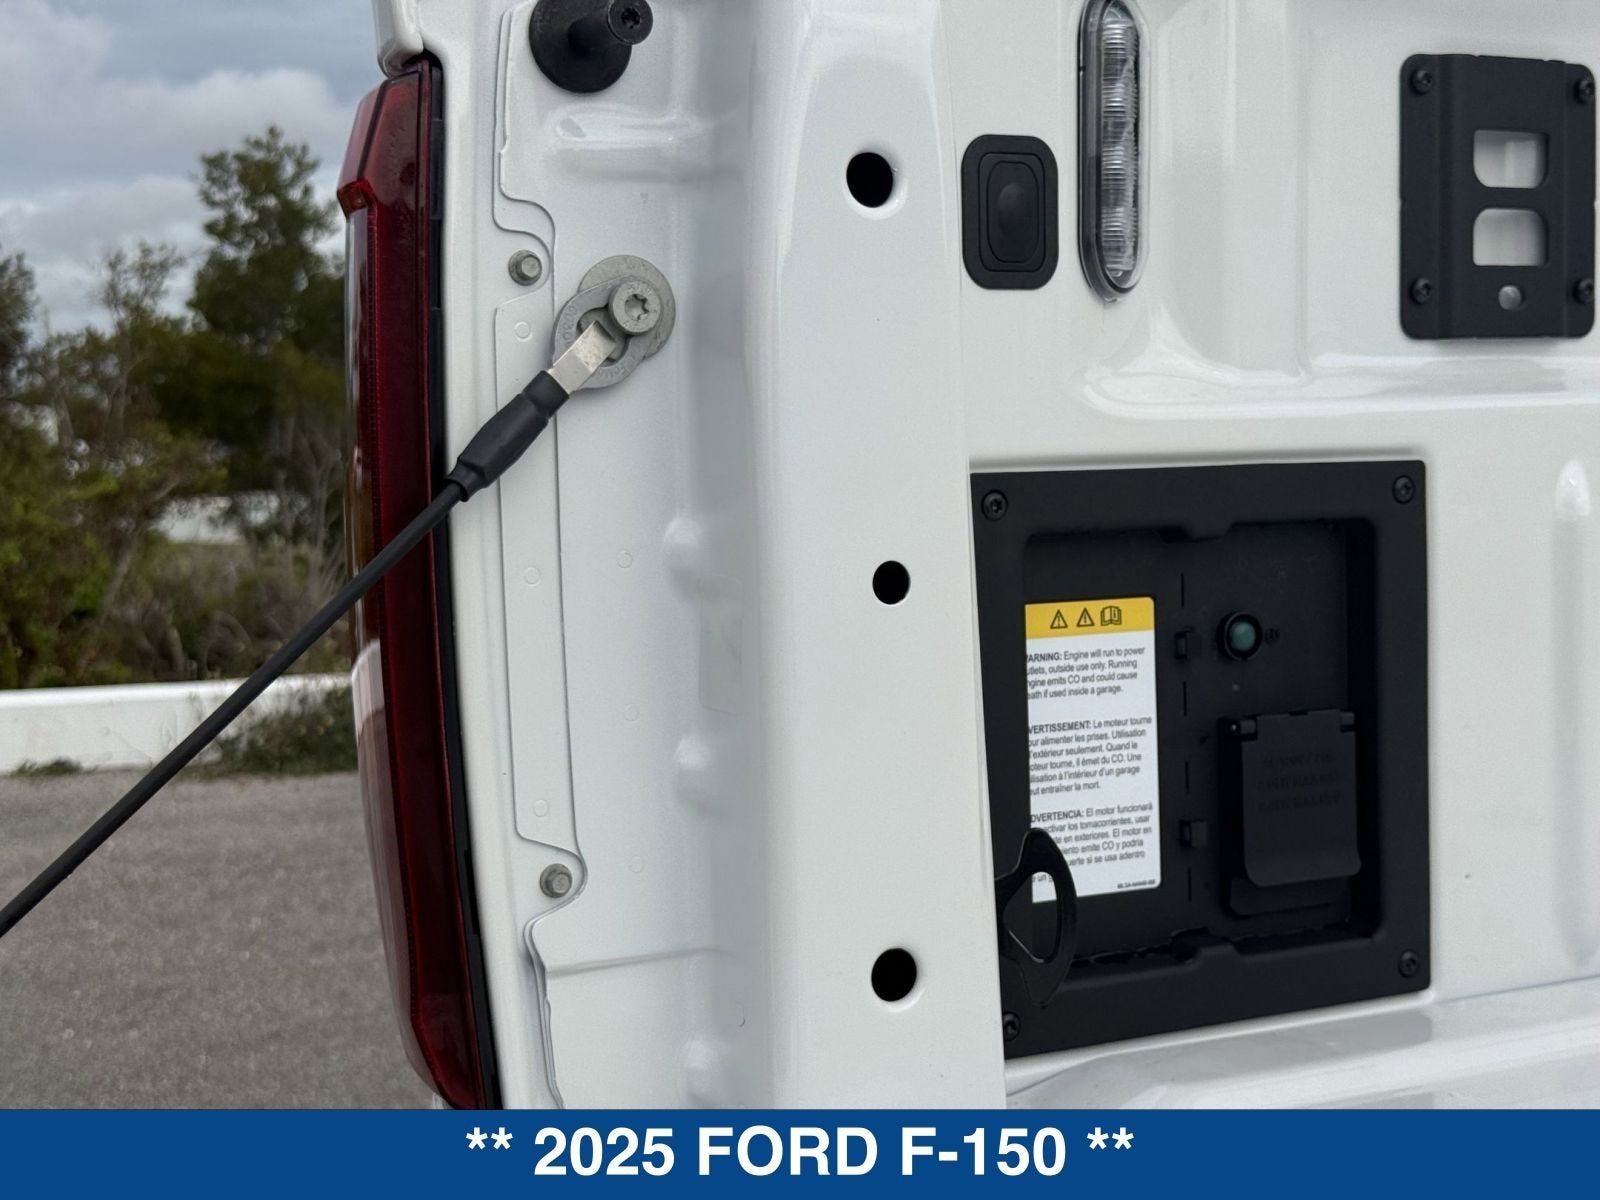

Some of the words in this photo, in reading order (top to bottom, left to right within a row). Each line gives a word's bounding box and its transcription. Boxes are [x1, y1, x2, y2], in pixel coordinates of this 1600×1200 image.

[1064, 649, 1089, 662] Engine
[1090, 648, 1101, 658] will
[1103, 649, 1114, 657] run
[1115, 647, 1122, 656] to
[1124, 647, 1145, 657] power
[1027, 665, 1047, 676] utlets,
[1048, 663, 1074, 674] outside
[1076, 663, 1089, 671] use
[1090, 660, 1106, 672] only.
[1108, 657, 1137, 671] Running
[1028, 678, 1045, 690] ngine
[1047, 676, 1066, 686] emits
[1067, 674, 1080, 684] CO
[1081, 674, 1095, 683] and
[1096, 672, 1115, 682] could
[1116, 672, 1138, 680] cause
[1028, 690, 1042, 700] eath
[1049, 687, 1066, 698] used
[1068, 685, 1089, 696] inside
[1096, 684, 1123, 696] garage.
[1029, 720, 1091, 734] VERTISSEMENT:
[1093, 719, 1102, 729] Le
[1104, 718, 1128, 728] moteur
[1130, 715, 1152, 725] tourne
[1028, 739, 1039, 747] our
[1040, 734, 1073, 746] alimenter
[1074, 733, 1085, 742] les
[1112, 728, 1146, 739] Utilisation
[1106, 741, 1130, 752] Quand
[1132, 741, 1138, 749] le
[1030, 762, 1048, 772] oteur
[1050, 760, 1075, 771] tourne,
[1101, 755, 1110, 764] du
[1111, 753, 1125, 764] CO.
[1127, 752, 1142, 762] Une
[1098, 767, 1114, 776] d'un
[1115, 766, 1140, 777] garage
[1030, 787, 1040, 796] eut
[1074, 782, 1081, 791] la
[1031, 809, 1084, 823] DVERTENCIA:
[1086, 808, 1094, 817] El
[1095, 806, 1115, 816] motor
[1068, 822, 1078, 831] los
[1135, 815, 1150, 824] usar
[1064, 835, 1073, 843] en
[1112, 828, 1120, 838] El
[1122, 827, 1141, 836] motor
[1143, 826, 1152, 834] en
[1081, 843, 1100, 853] emite
[1102, 840, 1114, 850] CO
[1122, 838, 1144, 849] podría
[1068, 857, 1085, 866] uerte
[1086, 855, 1092, 864] si
[1094, 855, 1103, 863] se
[1104, 854, 1117, 862] usa
[1119, 850, 1145, 860] adentro
[1038, 874, 1046, 882] un
